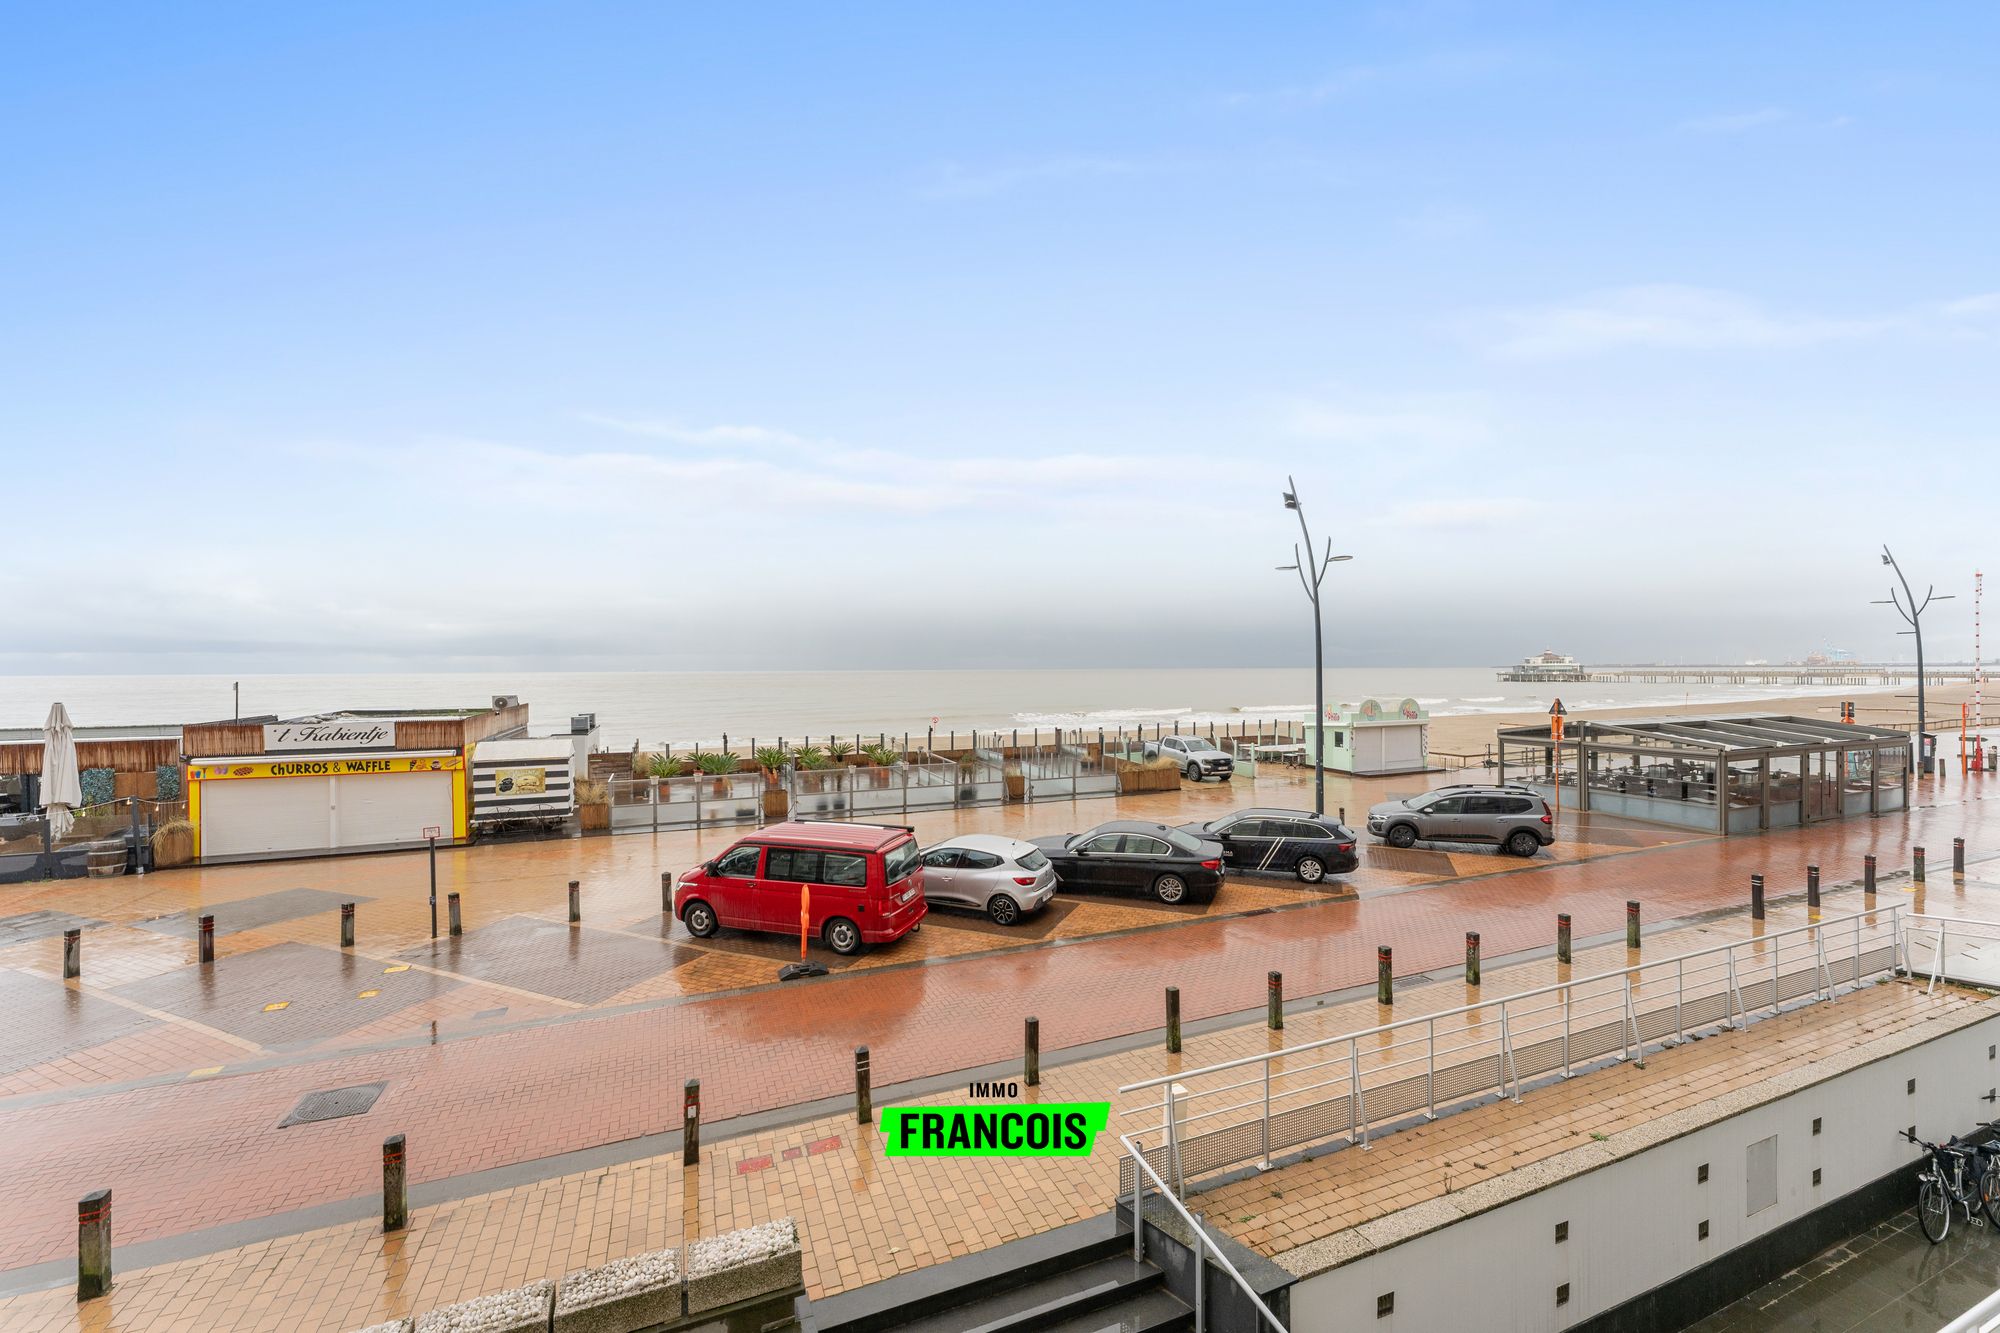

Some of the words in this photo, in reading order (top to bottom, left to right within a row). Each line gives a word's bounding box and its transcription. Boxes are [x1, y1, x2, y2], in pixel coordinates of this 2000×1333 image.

[294, 726, 388, 745] Kabientje
[332, 761, 341, 773] &
[346, 760, 391, 773] WAFFLE
